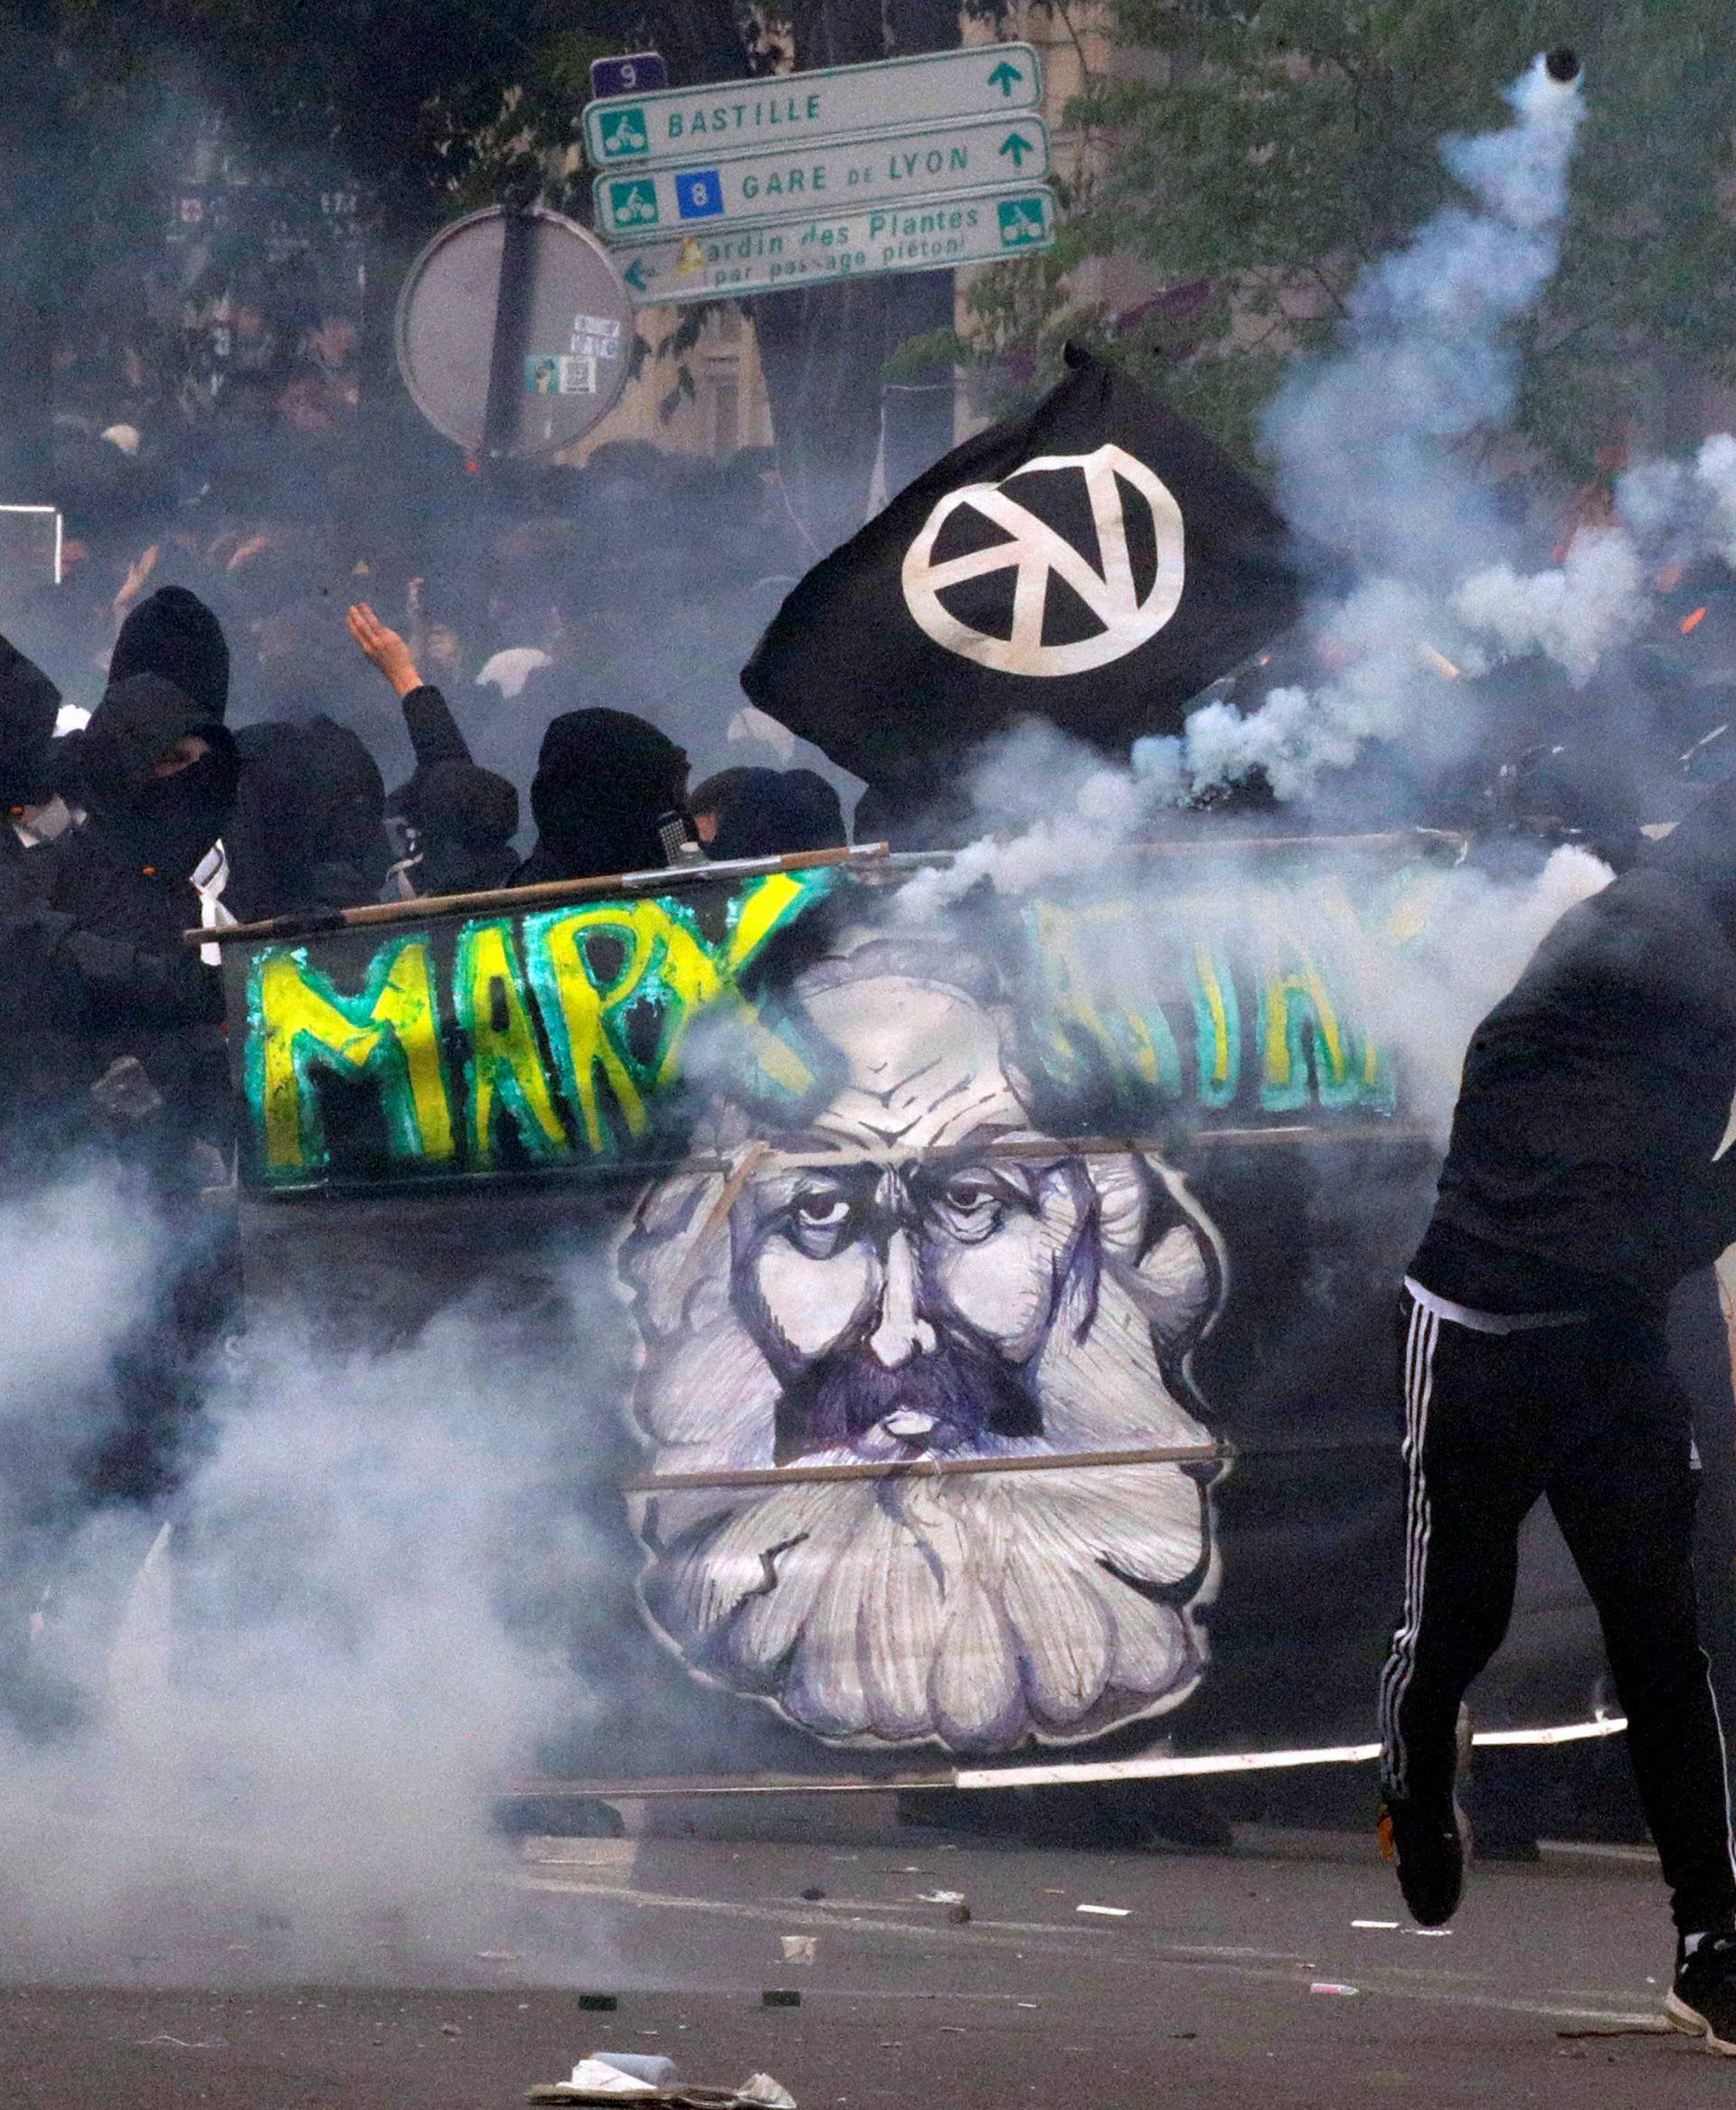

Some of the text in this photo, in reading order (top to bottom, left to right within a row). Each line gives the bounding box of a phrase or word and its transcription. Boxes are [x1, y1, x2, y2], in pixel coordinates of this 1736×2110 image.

[620, 64, 637, 89] 9
[668, 94, 821, 138] BASTILLE
[691, 183, 709, 207] 8
[742, 165, 826, 199] GARE
[889, 146, 969, 181] LYON
[707, 231, 783, 263] ardin
[869, 208, 979, 240] Plantes
[770, 250, 867, 283] pasage
[244, 864, 835, 1170] MARX
